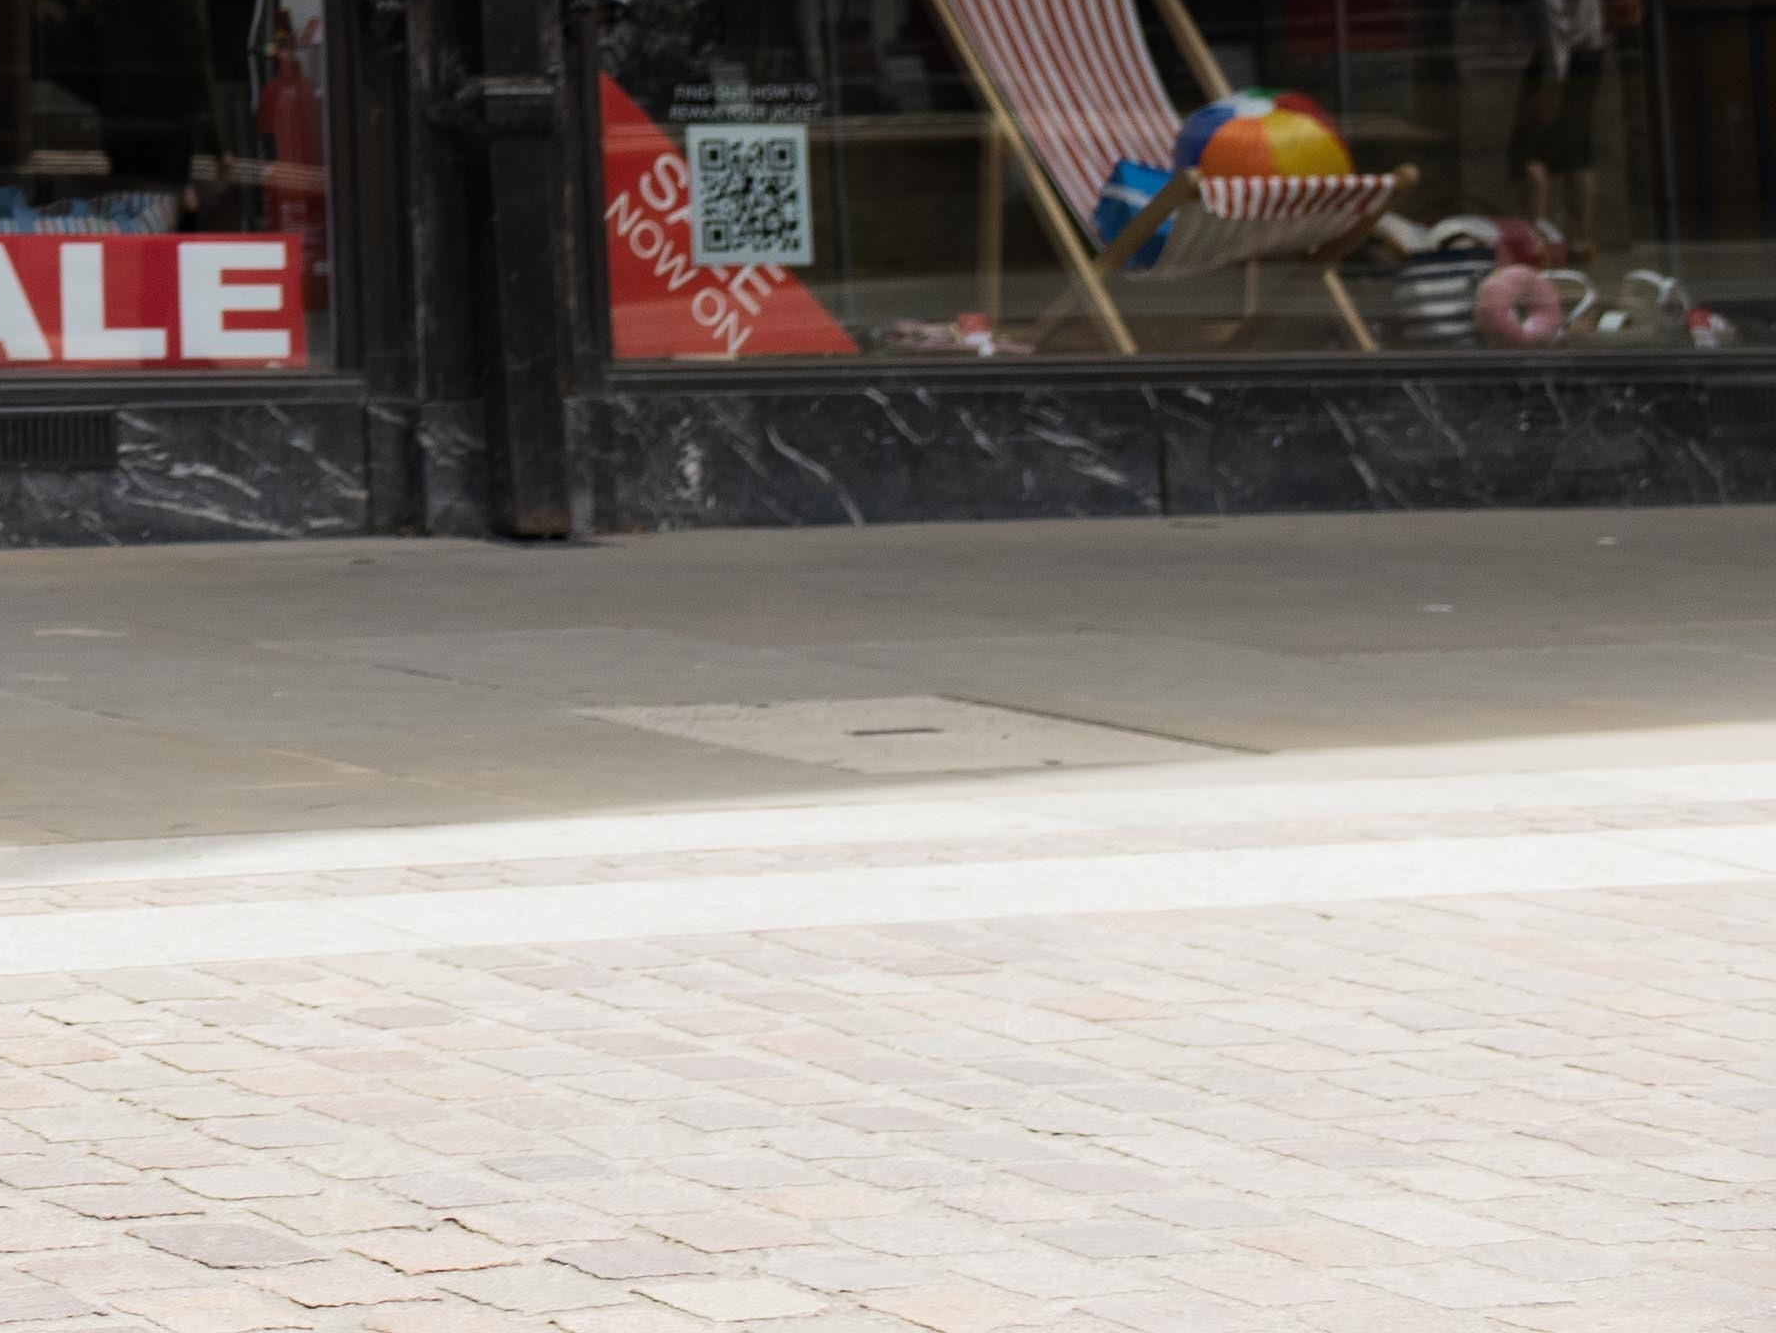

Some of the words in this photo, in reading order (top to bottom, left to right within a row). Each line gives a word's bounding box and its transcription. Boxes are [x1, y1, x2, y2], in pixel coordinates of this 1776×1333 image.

[604, 191, 697, 292] NOW
[691, 287, 754, 353] ON
[639, 153, 787, 316] SE
